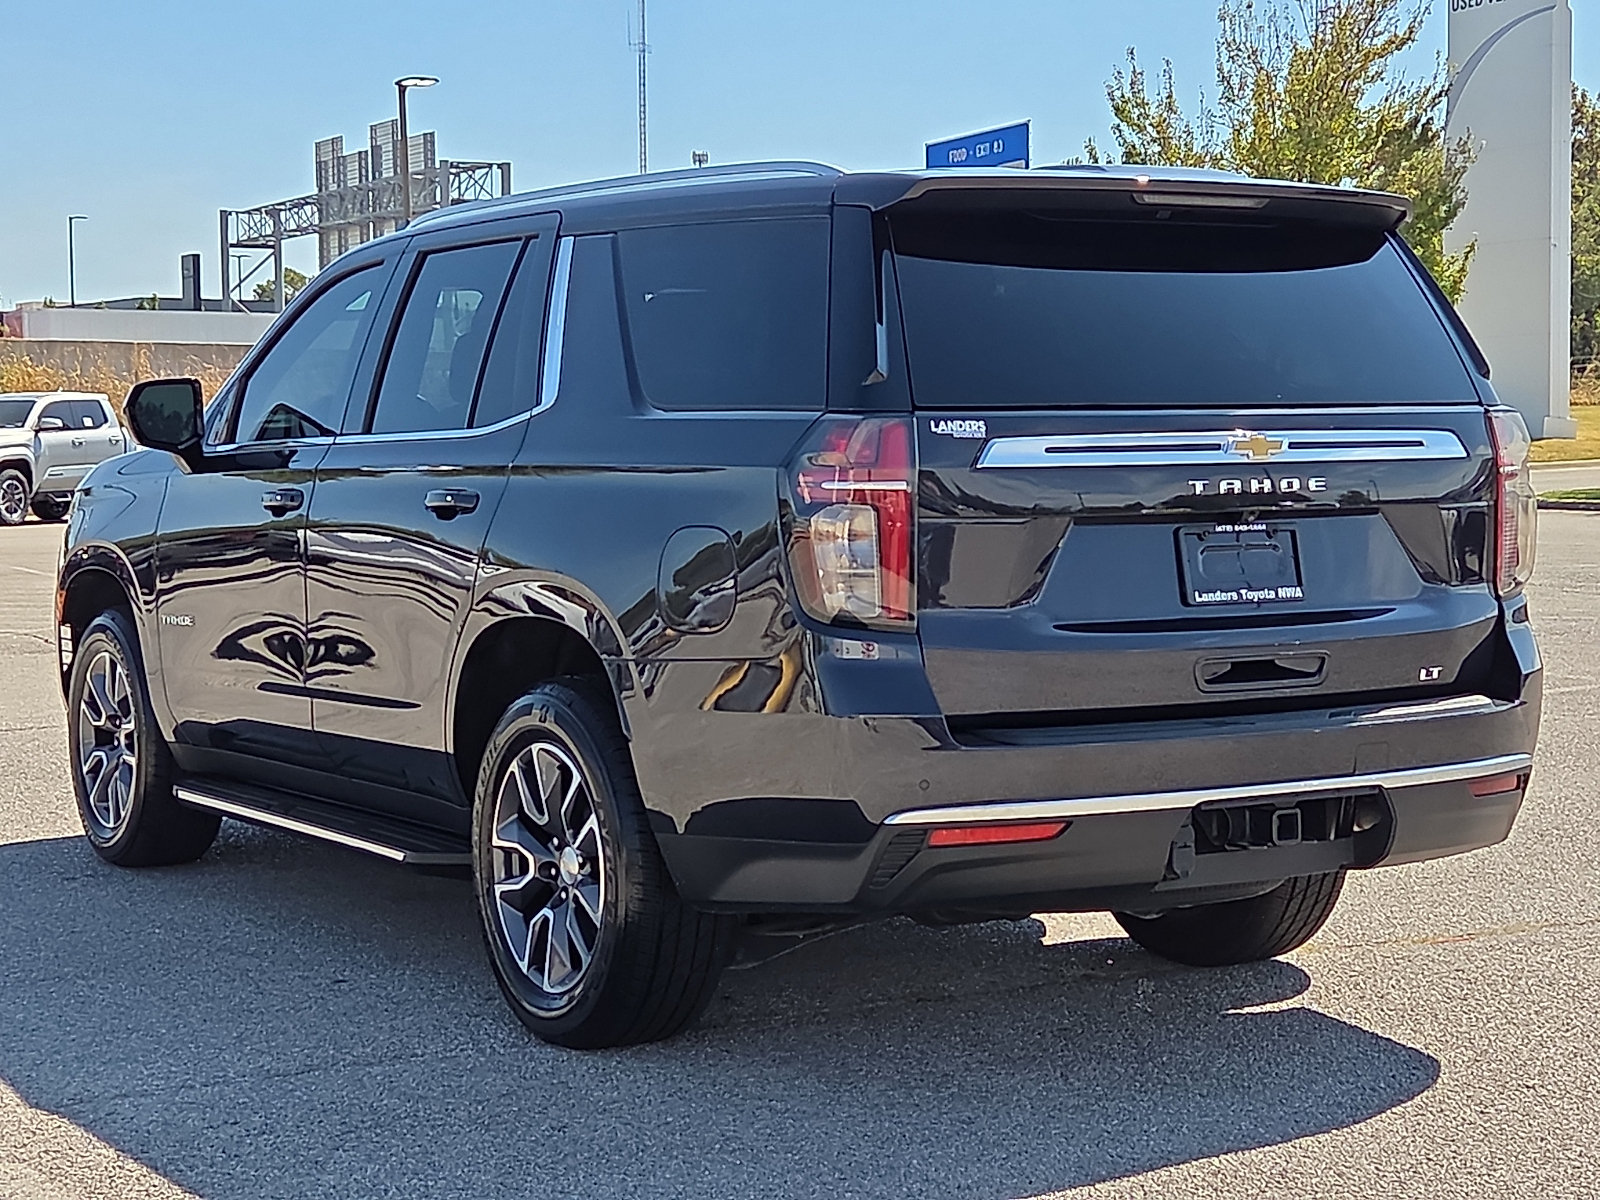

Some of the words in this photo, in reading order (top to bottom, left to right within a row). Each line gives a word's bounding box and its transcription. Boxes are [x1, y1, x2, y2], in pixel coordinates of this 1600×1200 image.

[929, 419, 987, 433] LANDERS
[1187, 477, 1328, 496] TAHOE
[1194, 590, 1238, 603] Landers
[1239, 587, 1276, 602] Toyota
[1277, 585, 1304, 599] NWA
[161, 614, 194, 627] TAHOE
[1420, 666, 1443, 680] LT
